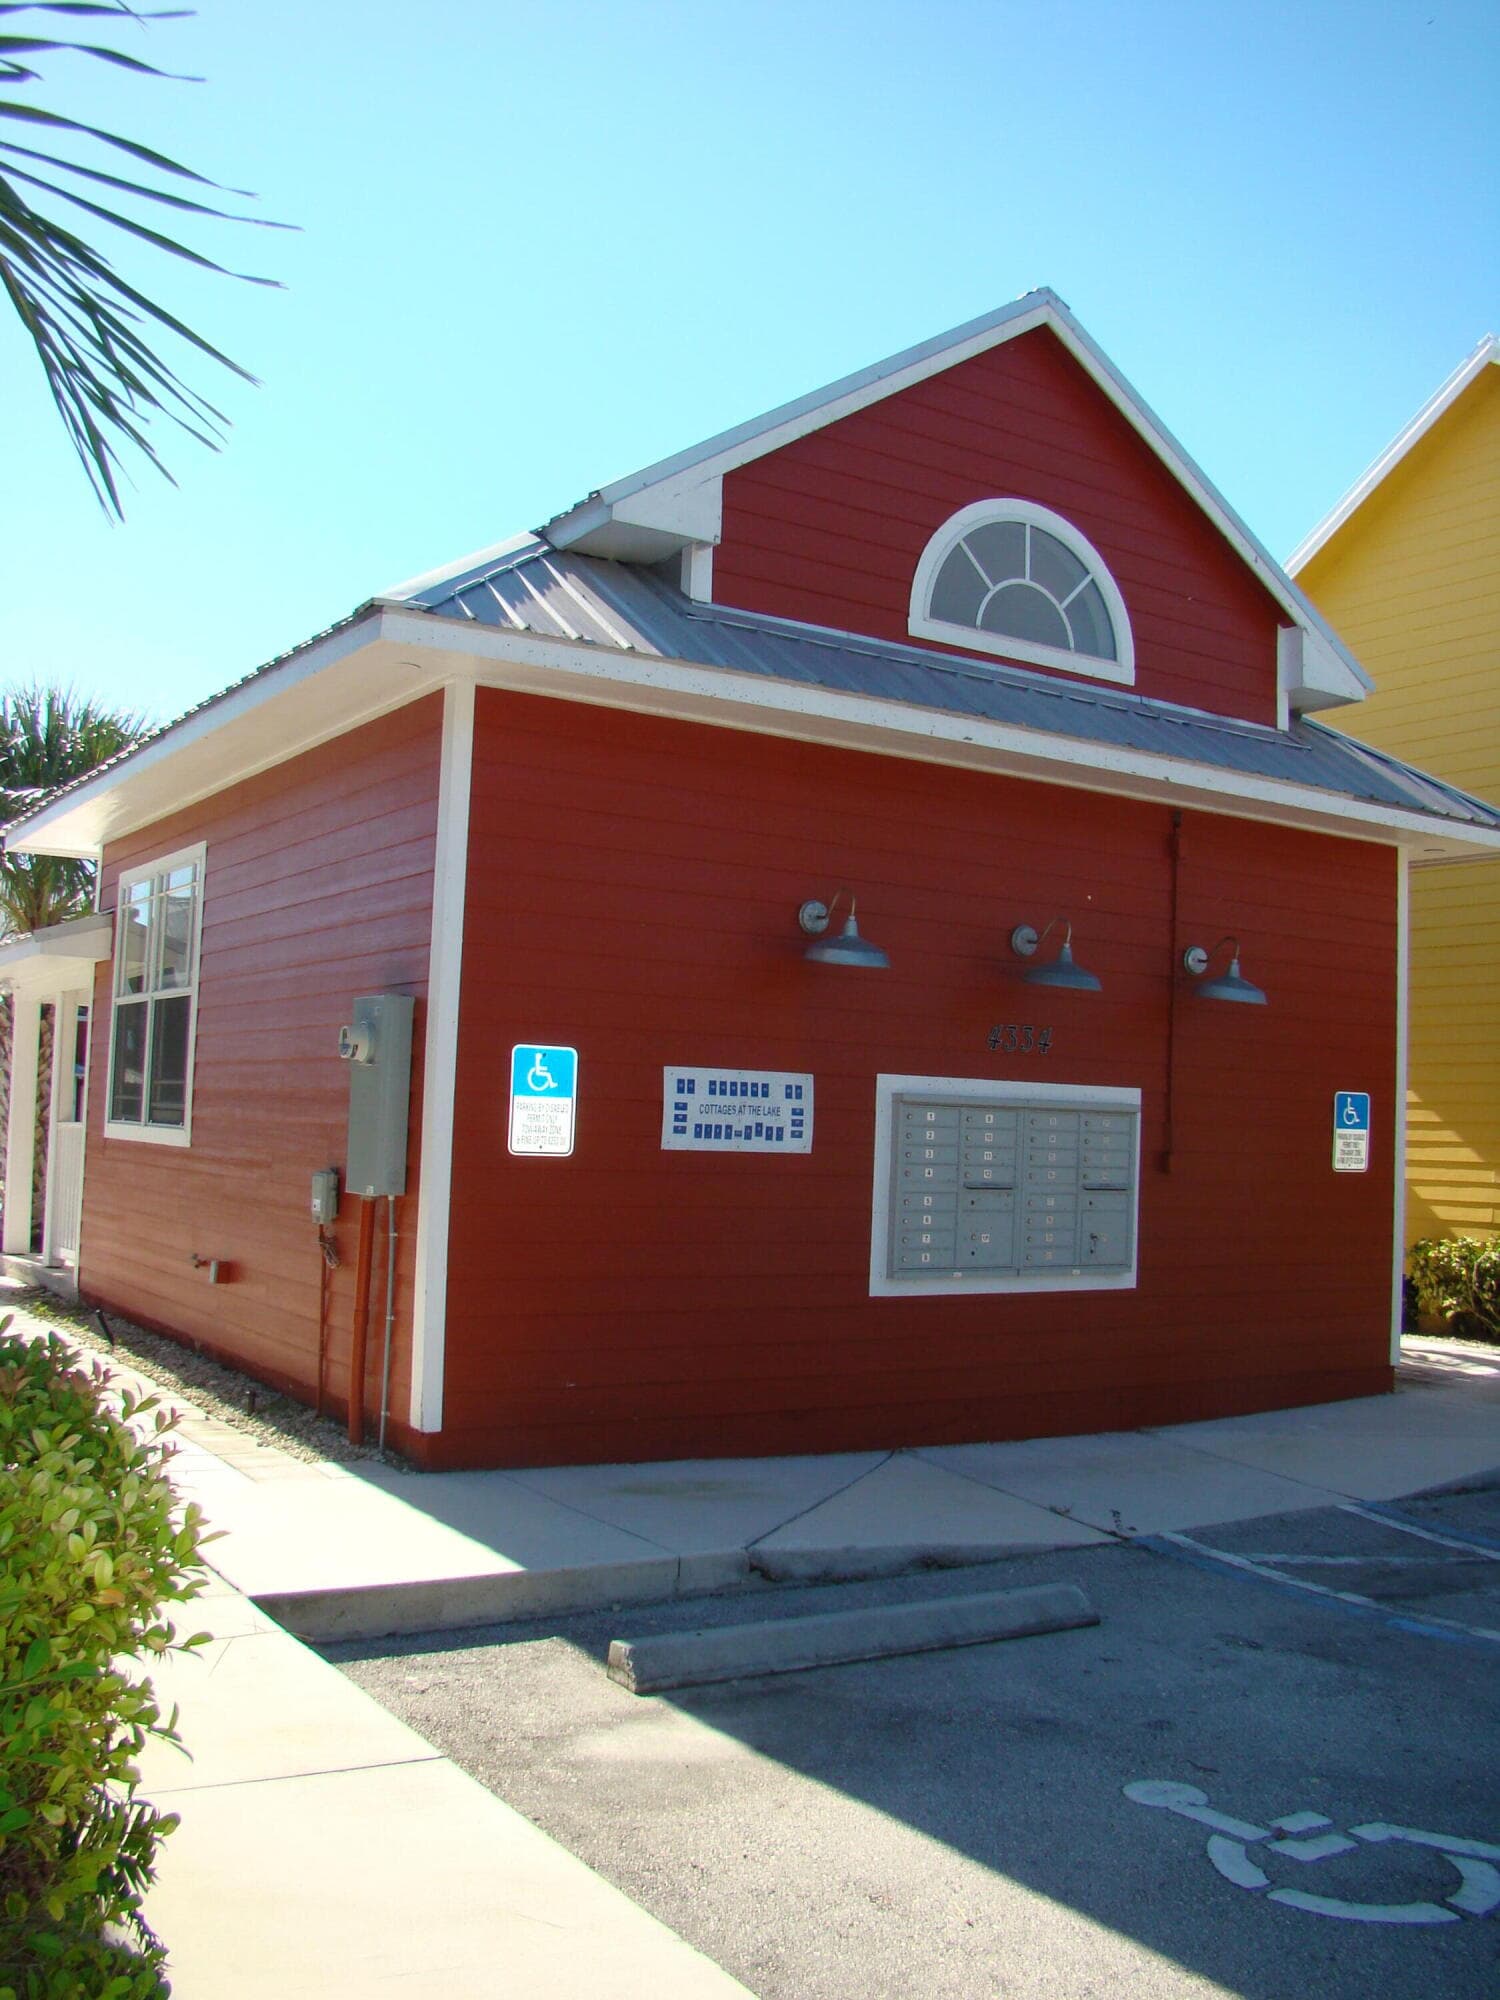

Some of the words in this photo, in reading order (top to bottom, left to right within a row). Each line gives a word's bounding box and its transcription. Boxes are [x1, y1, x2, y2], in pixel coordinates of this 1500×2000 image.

[987, 1024, 1053, 1053] 4334
[699, 1103, 736, 1115] COTTAGES
[738, 1104, 746, 1115] AT
[747, 1104, 760, 1116] THE
[763, 1105, 781, 1117] LAKE
